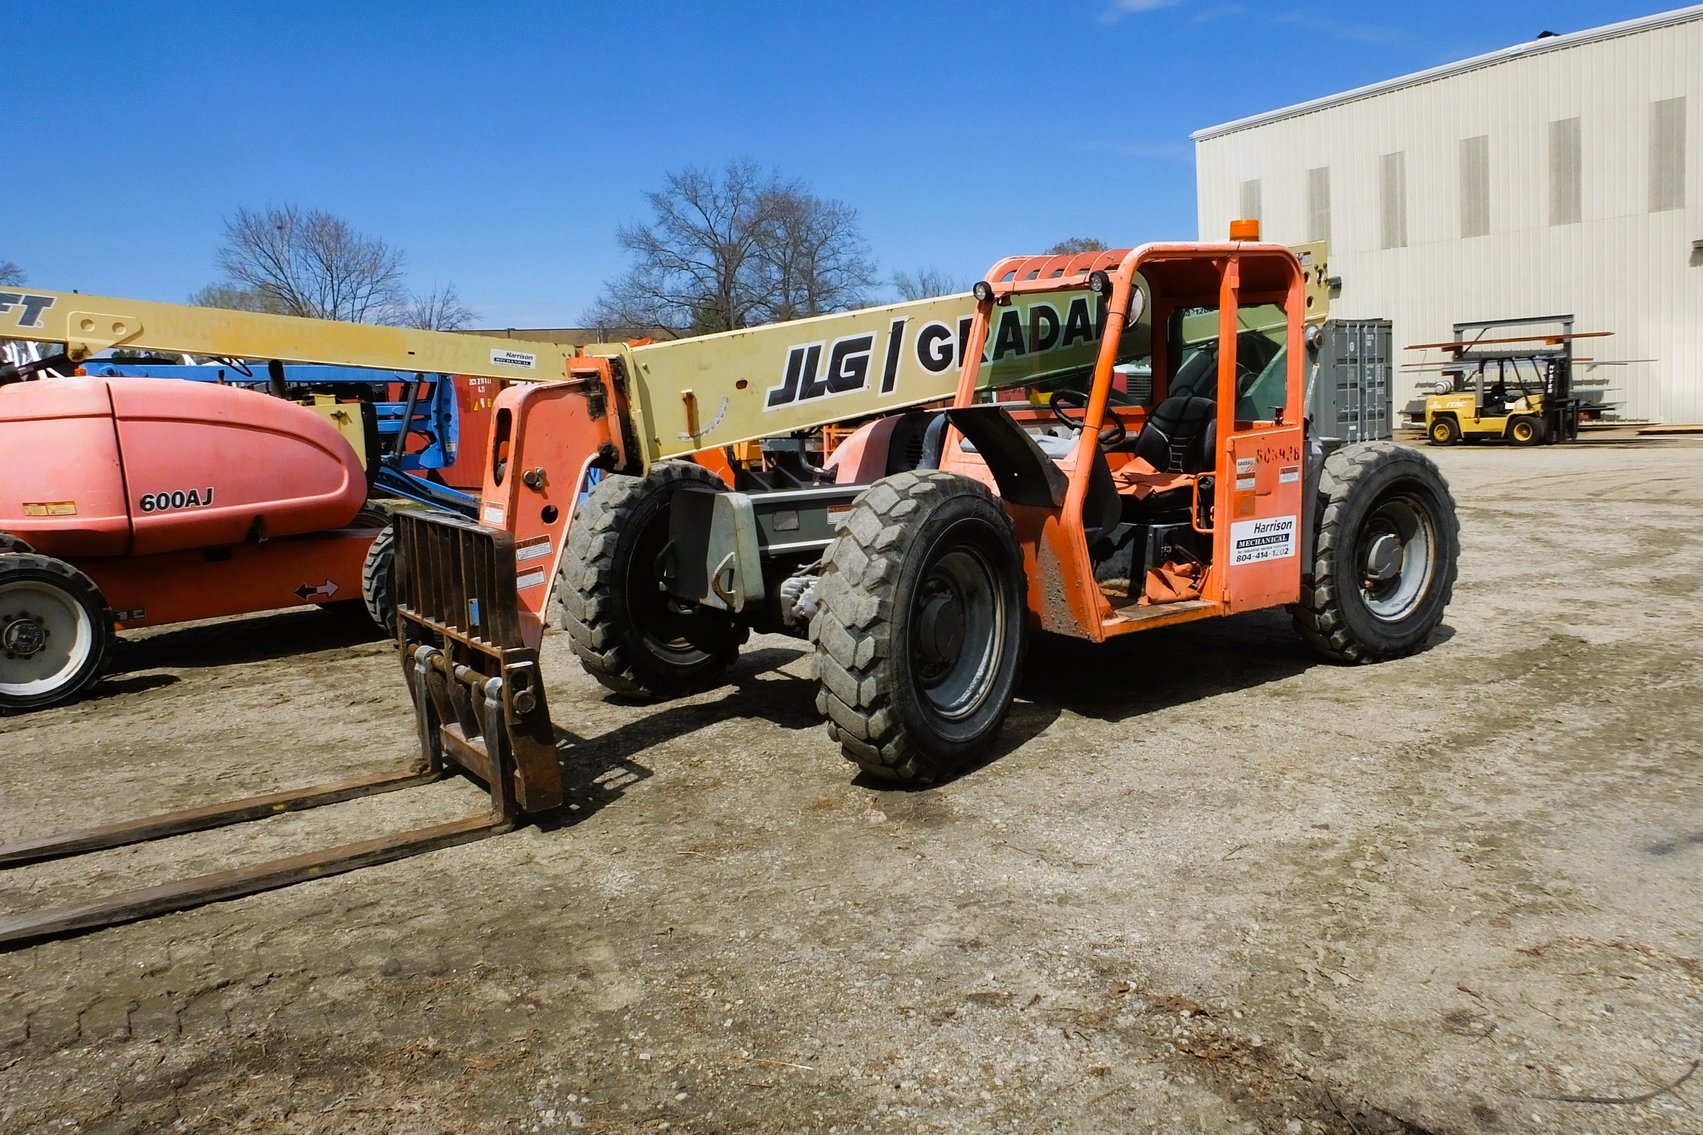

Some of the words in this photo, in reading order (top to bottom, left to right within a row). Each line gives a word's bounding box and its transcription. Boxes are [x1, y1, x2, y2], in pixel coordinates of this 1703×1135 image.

[505, 352, 533, 361] Harrison
[766, 333, 875, 409] JLG
[139, 487, 214, 512] 600AJ
[1253, 519, 1293, 534] Harrison
[1237, 534, 1290, 549] MECHANICAL
